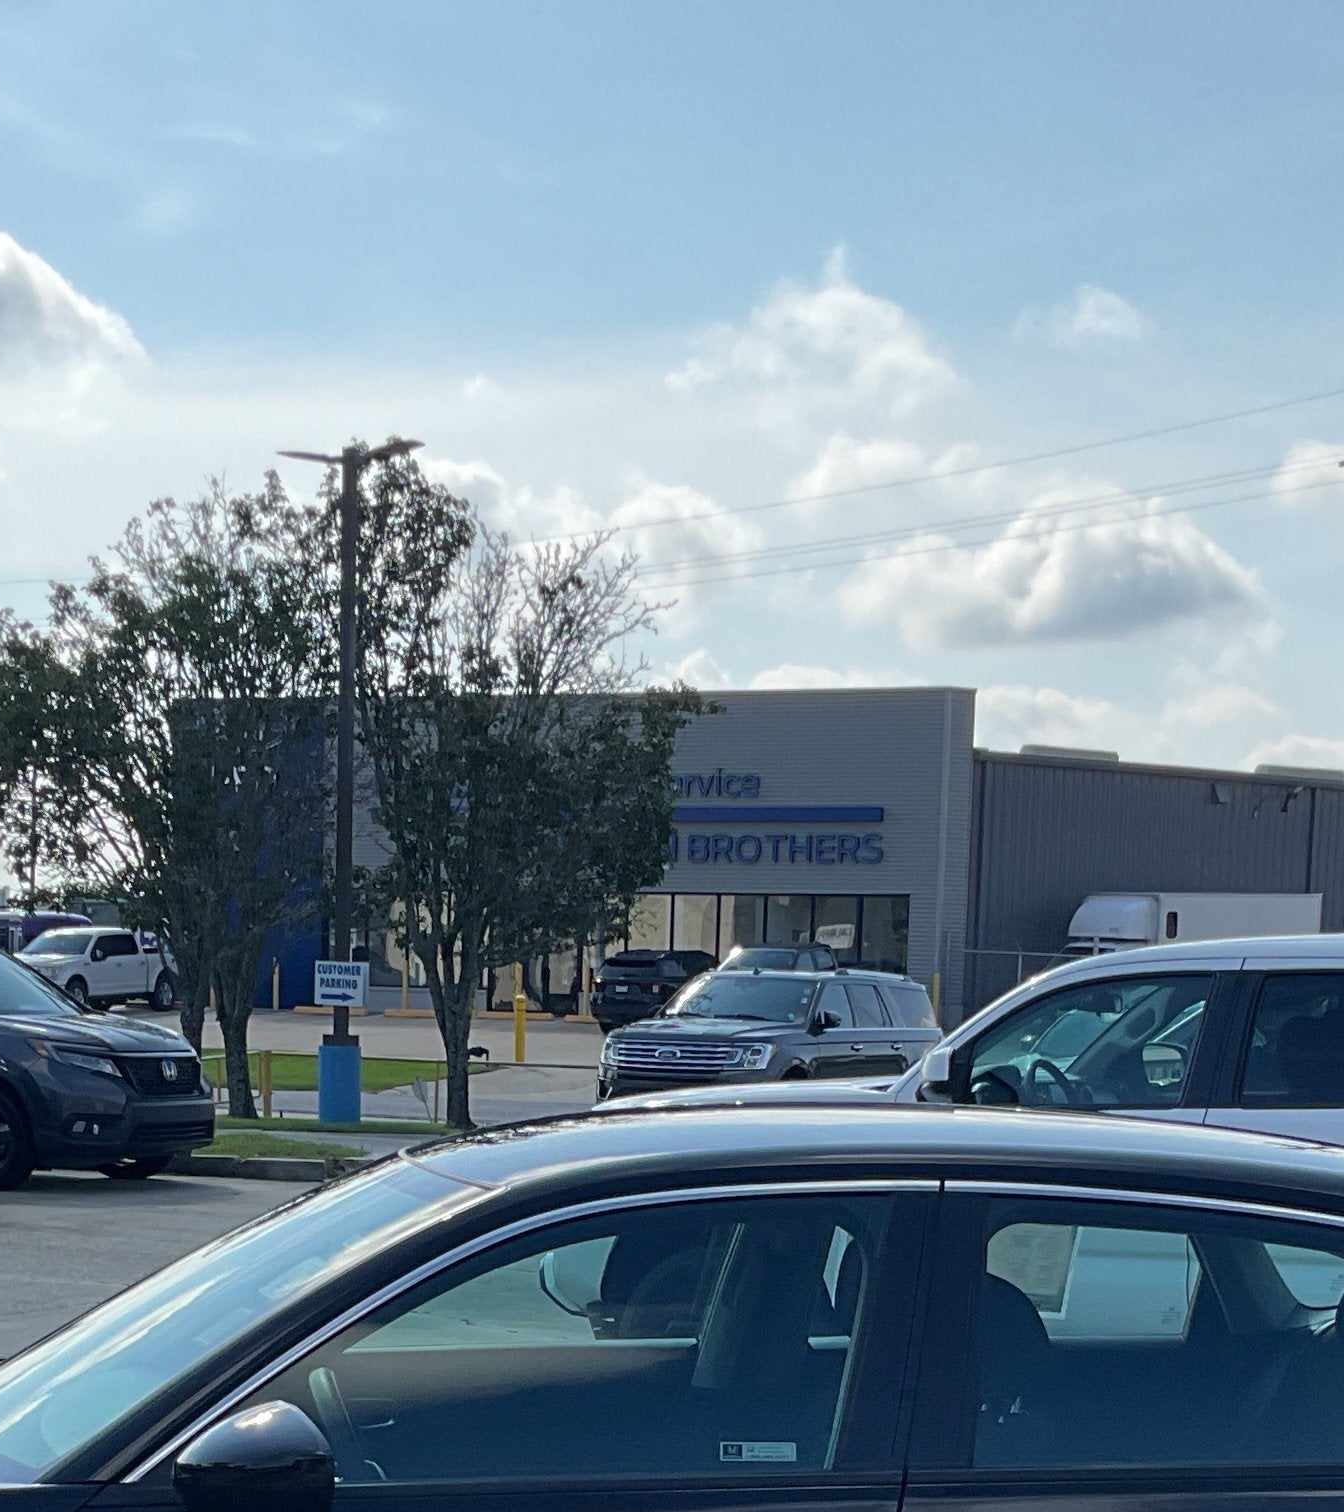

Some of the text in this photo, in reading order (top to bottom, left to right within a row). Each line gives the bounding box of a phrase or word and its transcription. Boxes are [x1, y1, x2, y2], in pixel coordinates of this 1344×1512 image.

[687, 832, 884, 865] BROTHERS
[317, 964, 361, 976] CUSTOMER
[320, 977, 358, 990] PARKING
